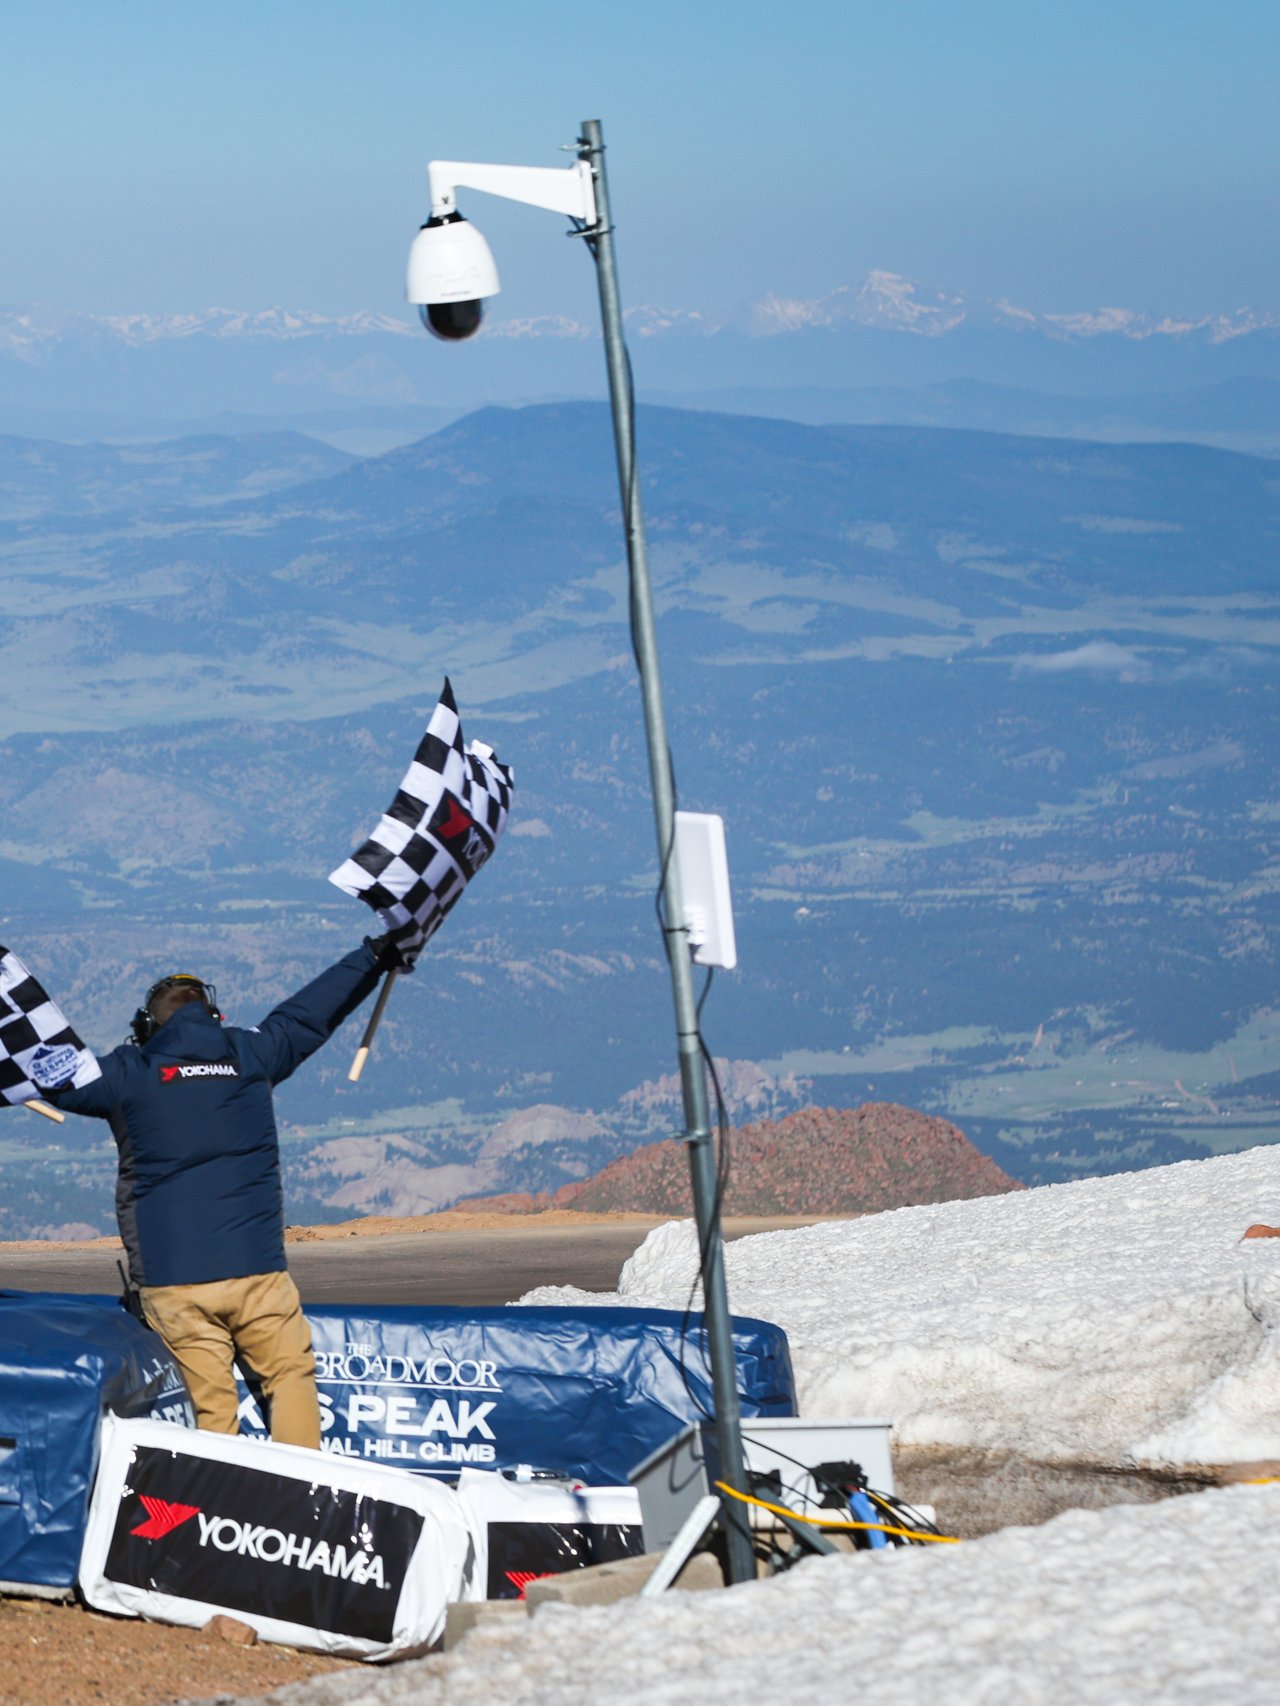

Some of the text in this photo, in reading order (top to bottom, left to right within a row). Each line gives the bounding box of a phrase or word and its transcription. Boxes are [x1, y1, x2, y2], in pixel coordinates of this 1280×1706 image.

[178, 1064, 238, 1077] YOKOHAMA
[347, 1343, 372, 1355] THE
[314, 1352, 502, 1388] BROADMOOR
[347, 1394, 497, 1440] PEAK
[364, 1438, 417, 1460] HILL
[420, 1441, 496, 1463] CLIMB
[198, 1512, 385, 1590] YOKOHAMA
